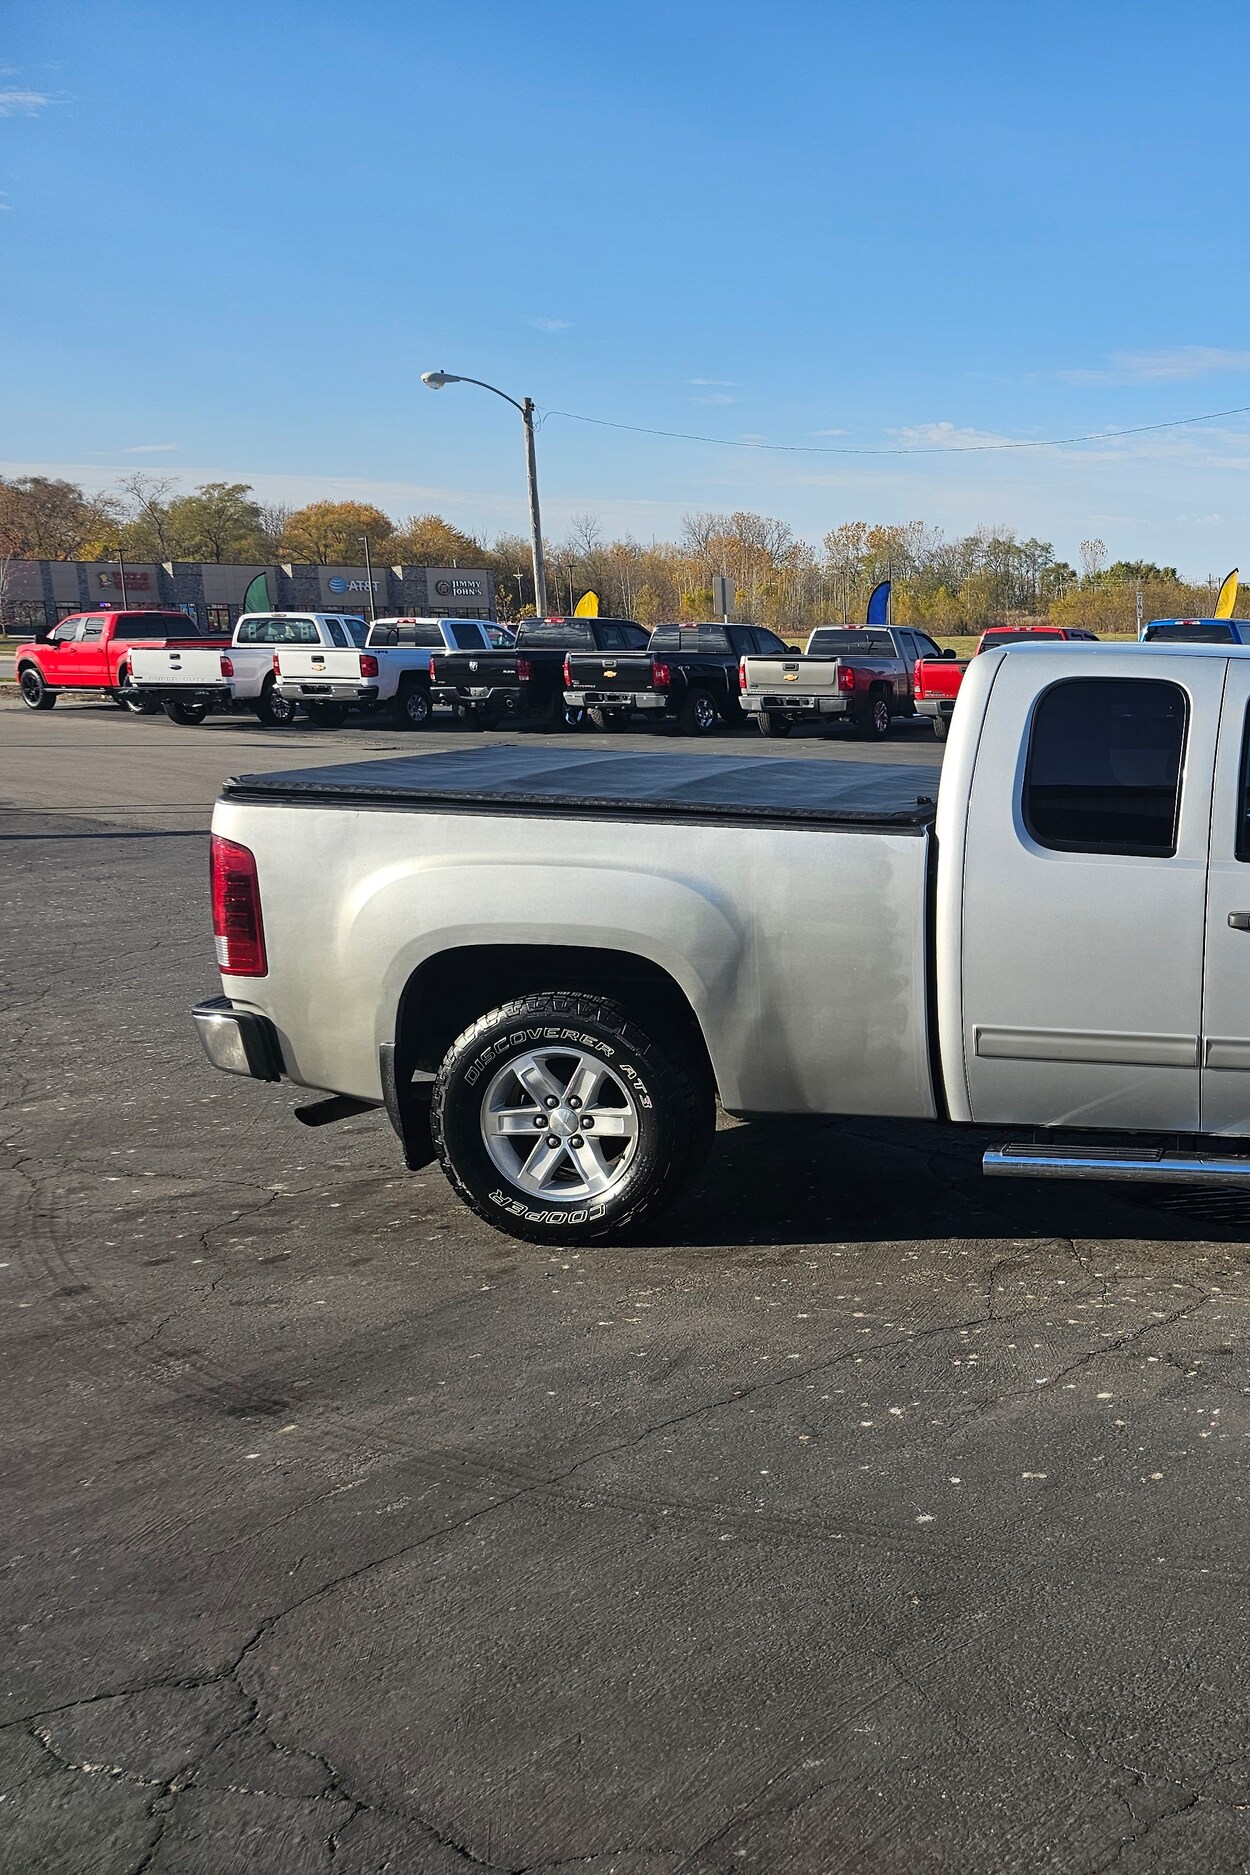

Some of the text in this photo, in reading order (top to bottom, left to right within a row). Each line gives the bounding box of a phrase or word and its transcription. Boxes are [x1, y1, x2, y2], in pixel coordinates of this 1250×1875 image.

[348, 580, 380, 591] AT&T
[452, 580, 481, 588] JIMMY
[452, 588, 482, 596] JOHN'S
[463, 1027, 653, 1110] DISCOVERER AT3
[488, 1188, 606, 1225] COOPER
